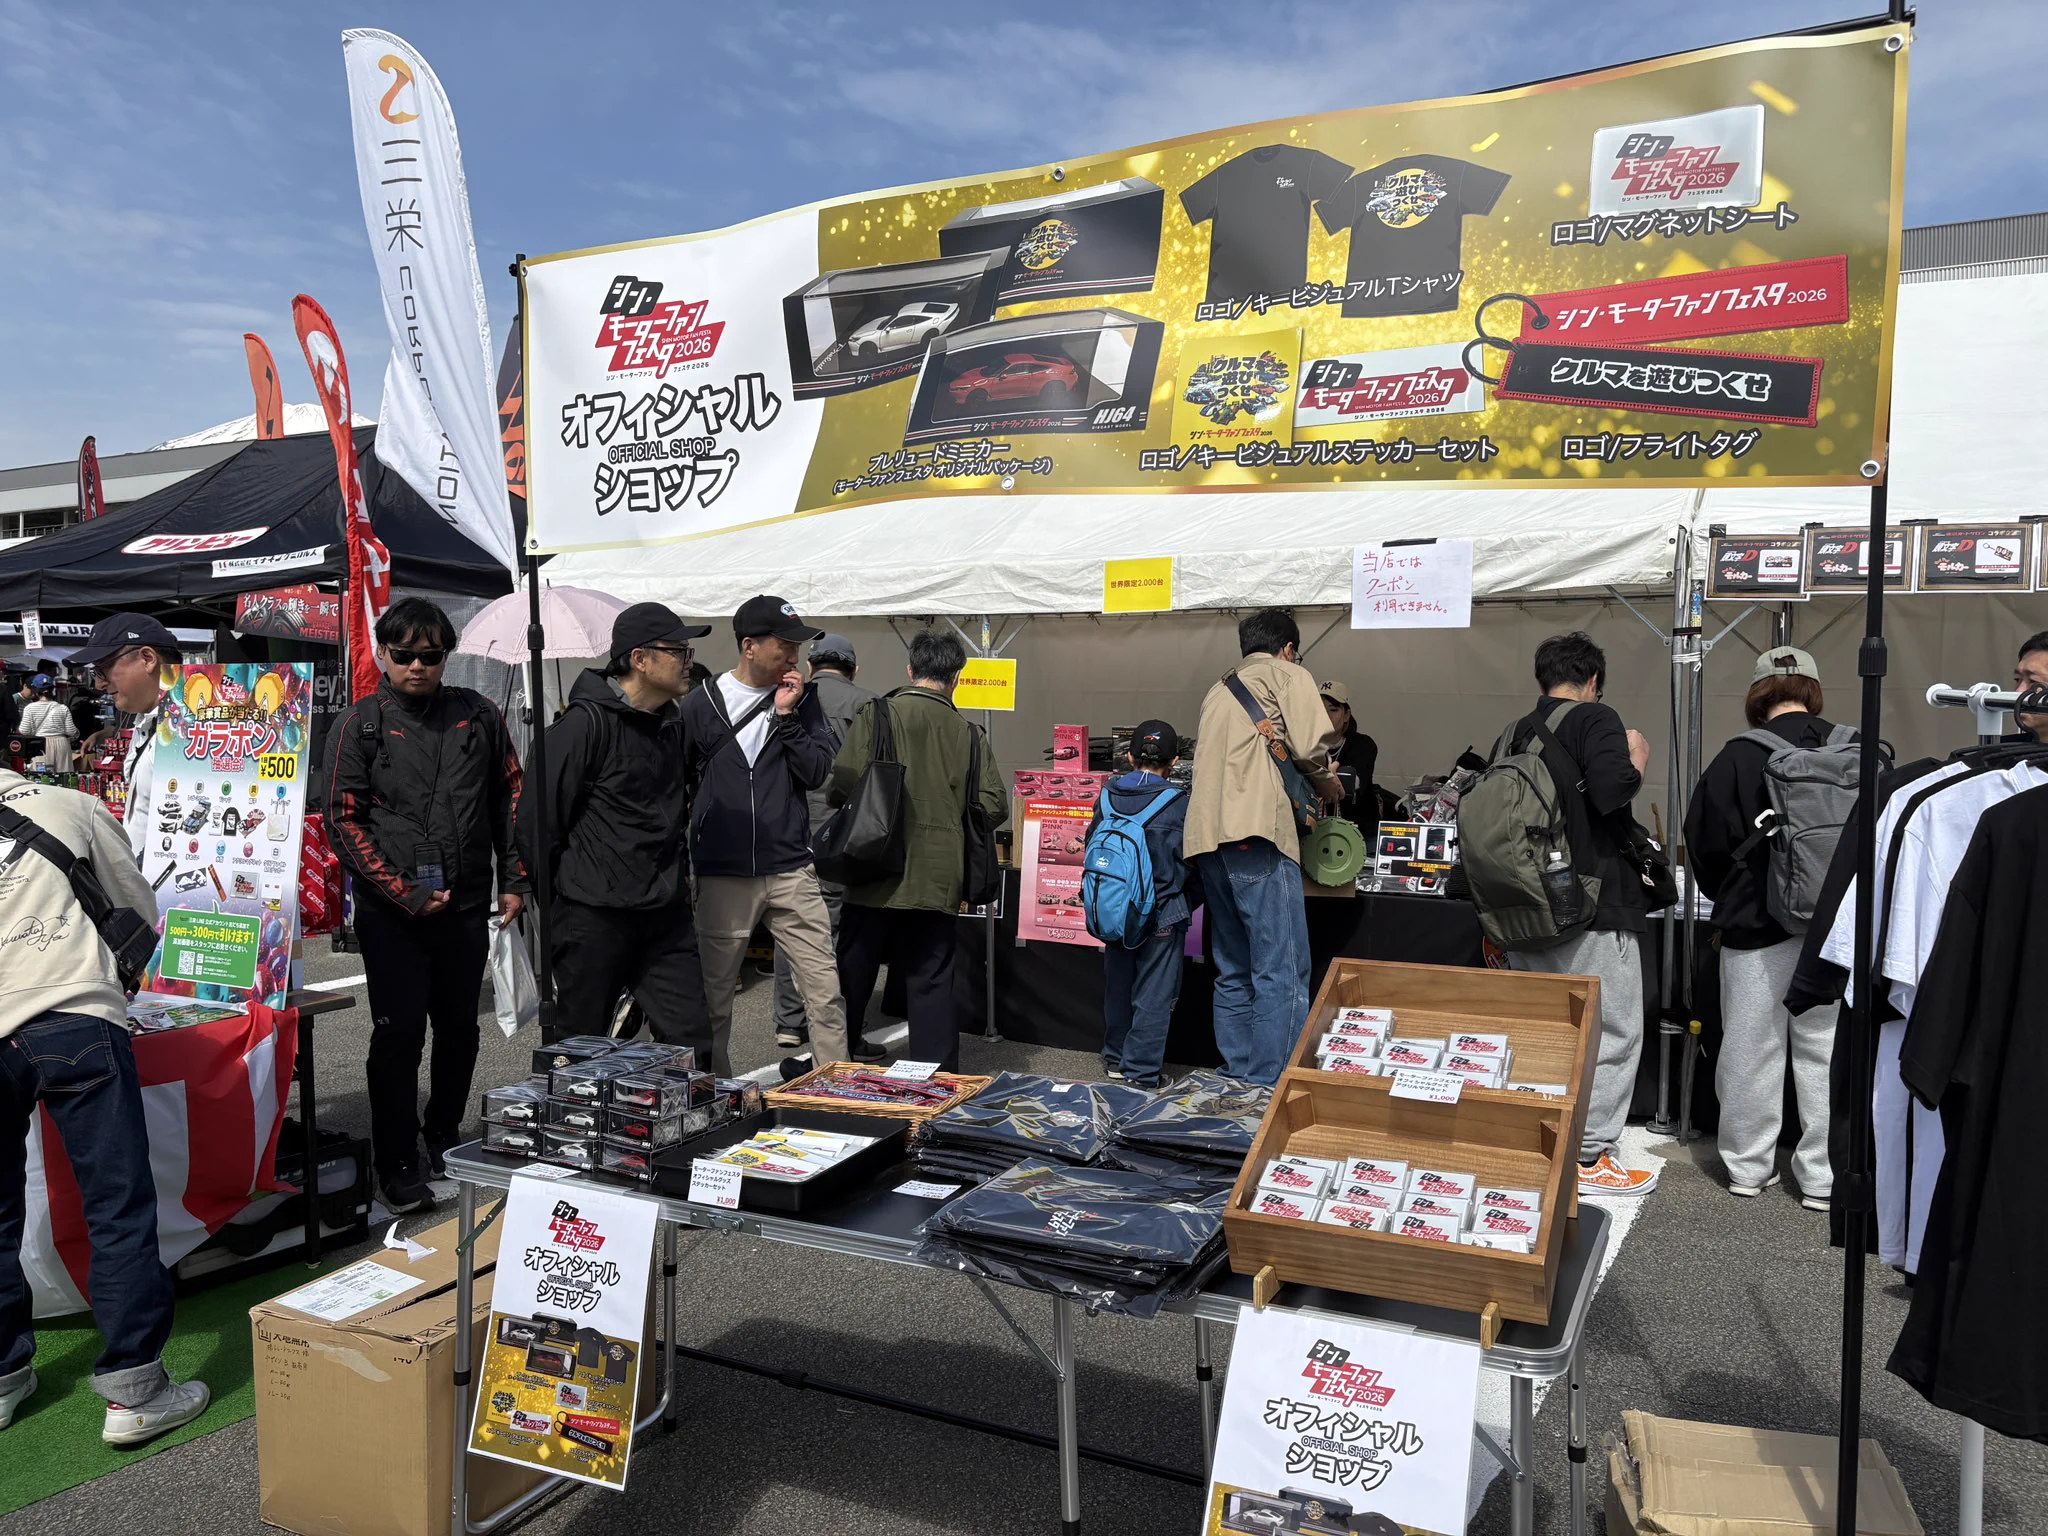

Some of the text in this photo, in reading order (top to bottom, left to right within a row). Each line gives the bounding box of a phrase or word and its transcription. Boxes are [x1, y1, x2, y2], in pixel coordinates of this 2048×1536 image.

[1627, 136, 1664, 157] シン・
[1624, 149, 1715, 177] モーターファン
[1637, 167, 1726, 198] フェスタ 2026
[611, 281, 653, 312] シン・
[1556, 281, 1828, 331] シン・モーターファンフェスタ 2026
[608, 303, 706, 342] モーターファン
[622, 333, 712, 377] フェスタ 2026
[1315, 363, 1352, 387] シン・
[1550, 356, 1772, 402] クルマを遊びつくせ
[562, 373, 782, 448] オフィシャル
[1408, 392, 1439, 405] 2026
[1093, 406, 1137, 425] HJ64
[608, 437, 717, 464] OFFICIAL SHOP
[869, 438, 1011, 474] プレリュードミニカー
[594, 449, 740, 516] ショップ
[1362, 550, 1423, 573] 当店では
[1365, 576, 1416, 595] クーポン
[184, 720, 277, 760] ガラポン
[716, 1196, 737, 1206] ¥1,000
[581, 1238, 599, 1249] 2026
[524, 1247, 621, 1287] オフィシャル
[536, 1280, 602, 1314] ショップ
[575, 1279, 594, 1290] SHOP
[1315, 1342, 1343, 1364] シン・
[1312, 1361, 1380, 1387] モーターファン
[1320, 1377, 1385, 1405] フェスタ 2026
[1264, 1397, 1424, 1456] オフィシャル
[1300, 1435, 1378, 1459] OFFICIAL SHOP
[1286, 1443, 1392, 1491] ショップ
